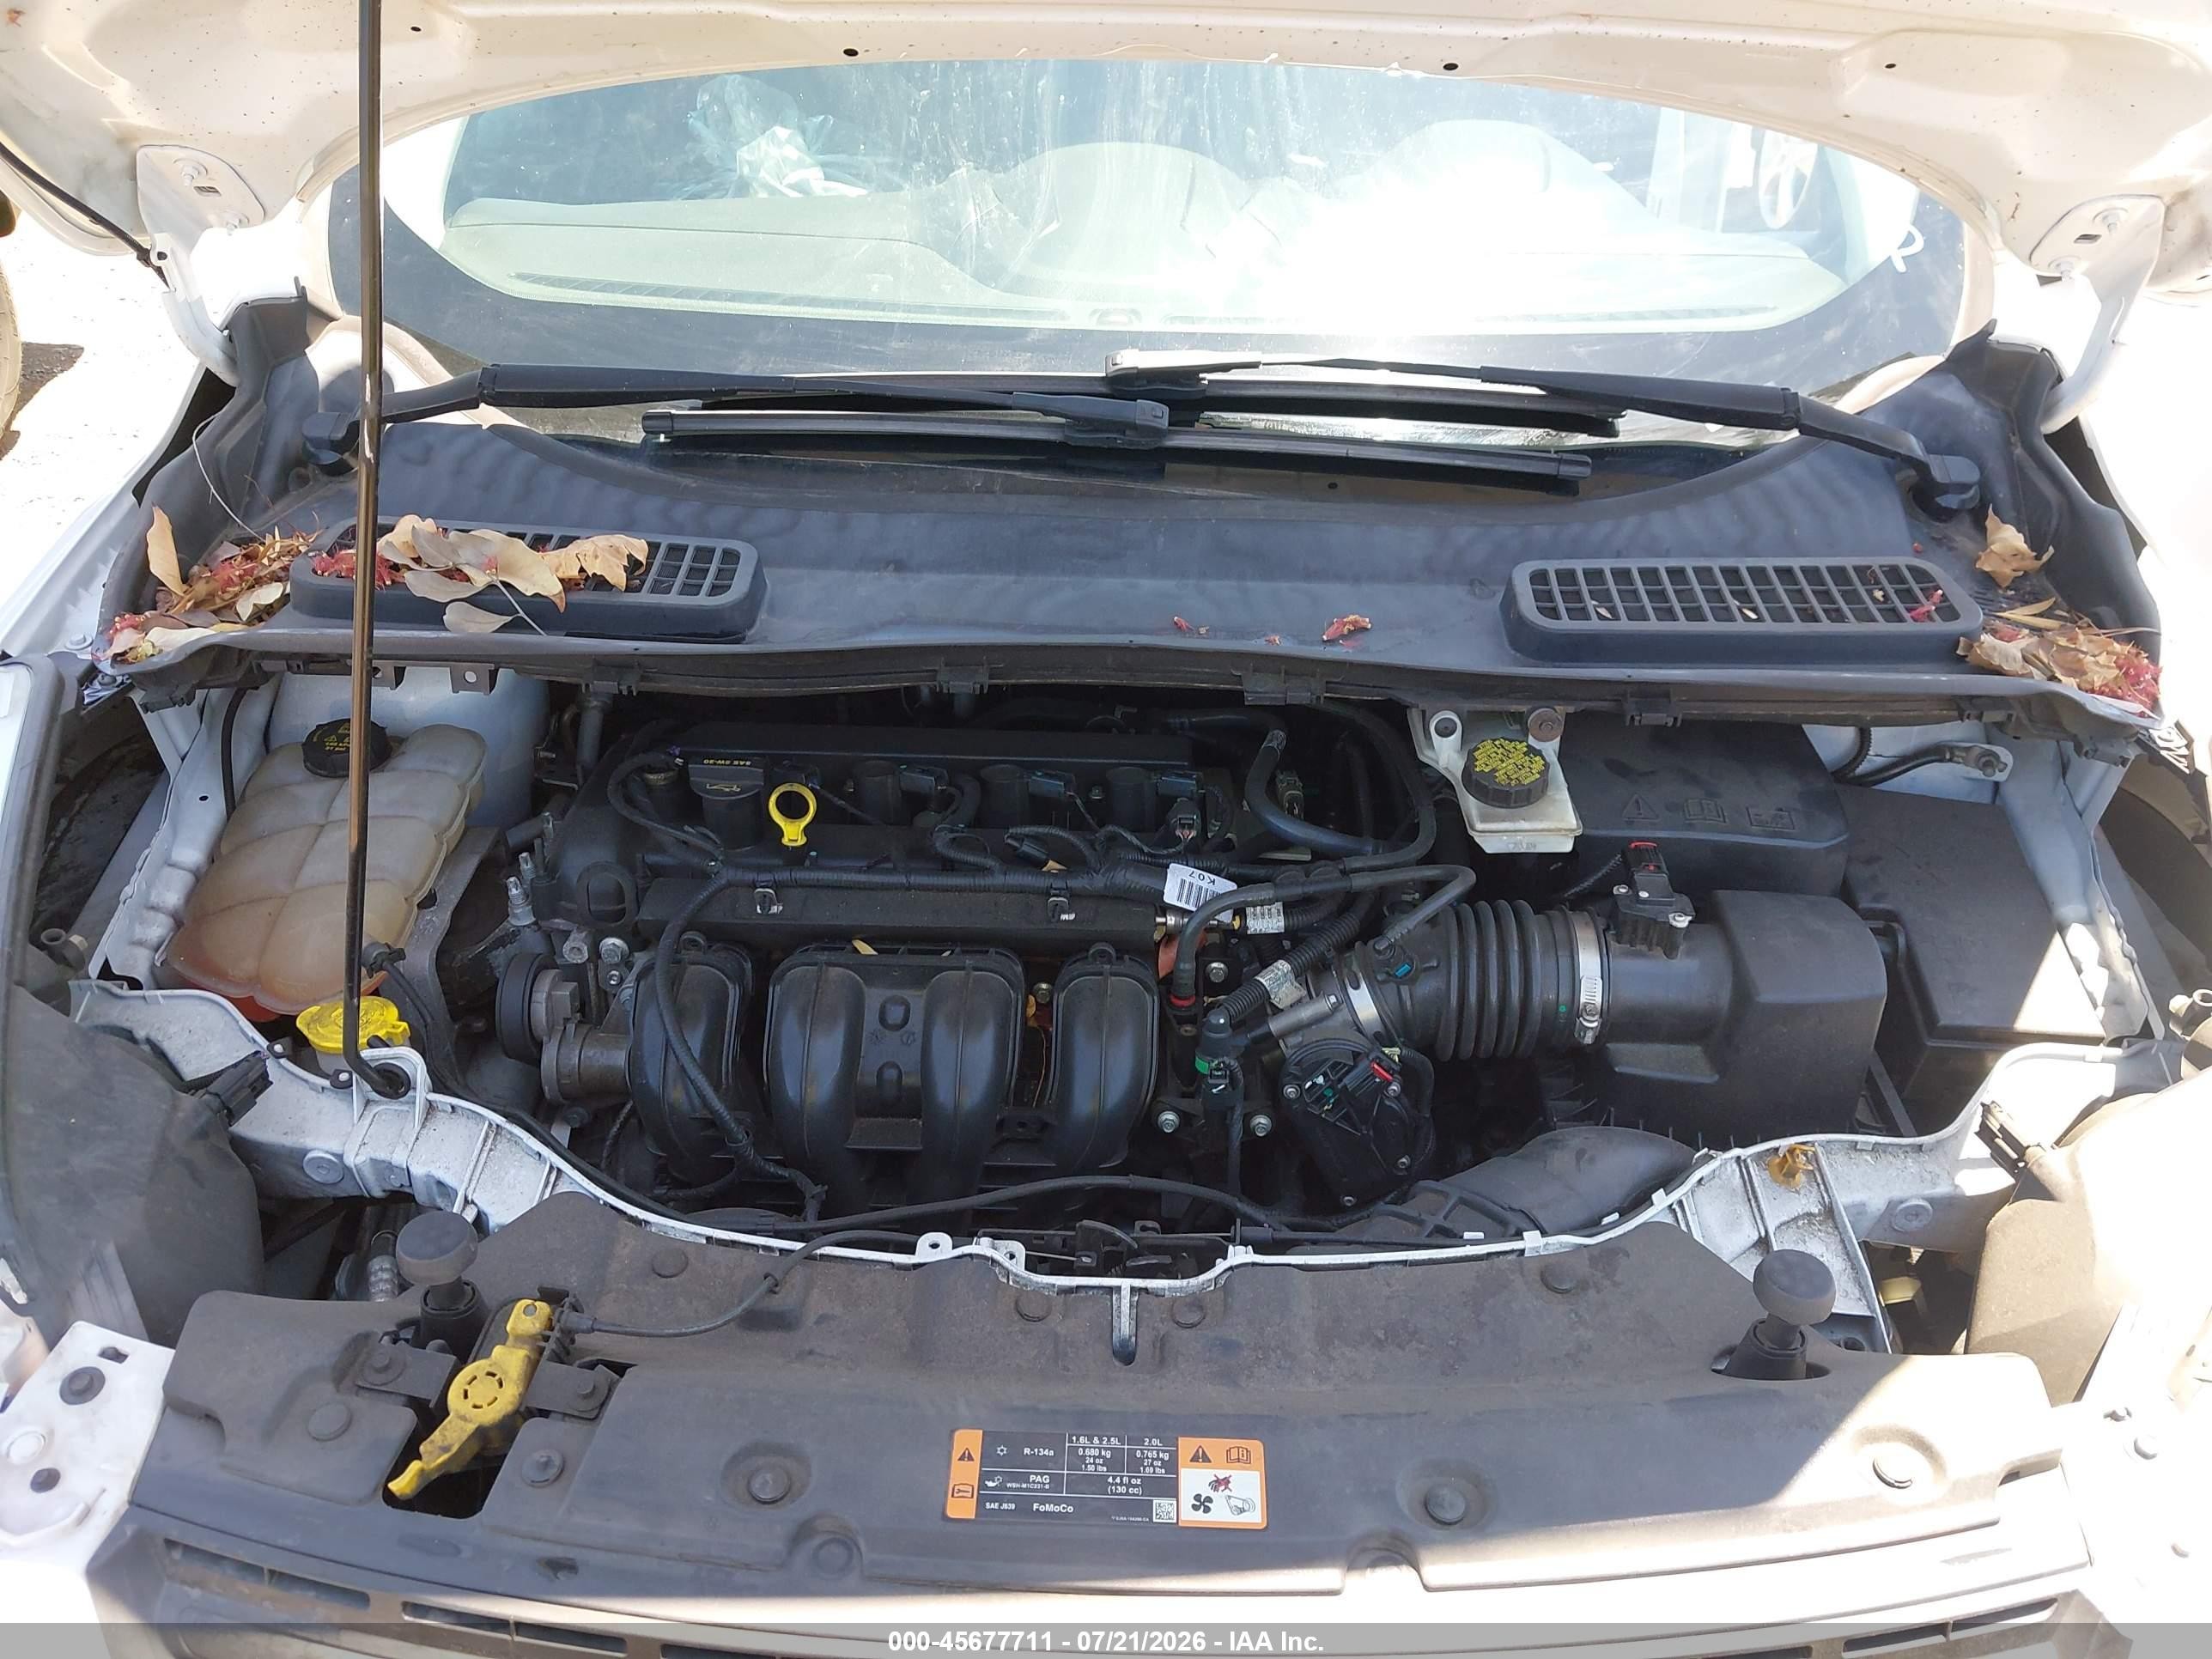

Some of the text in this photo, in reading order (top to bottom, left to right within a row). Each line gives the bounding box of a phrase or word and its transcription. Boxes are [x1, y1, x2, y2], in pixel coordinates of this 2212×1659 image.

[1188, 870, 1216, 885] K07
[1072, 1436, 1091, 1444] 1.6L
[1102, 1437, 1121, 1445] 2.5L
[1144, 1437, 1163, 1446] 2.0L
[1024, 1447, 1054, 1456] R-134a
[1102, 1449, 1111, 1458] kg
[1159, 1451, 1169, 1461] kg
[1030, 1474, 1050, 1483] PAG
[1108, 1486, 1142, 1496] (130 cc)
[1033, 1503, 1074, 1513] FoMoCo
